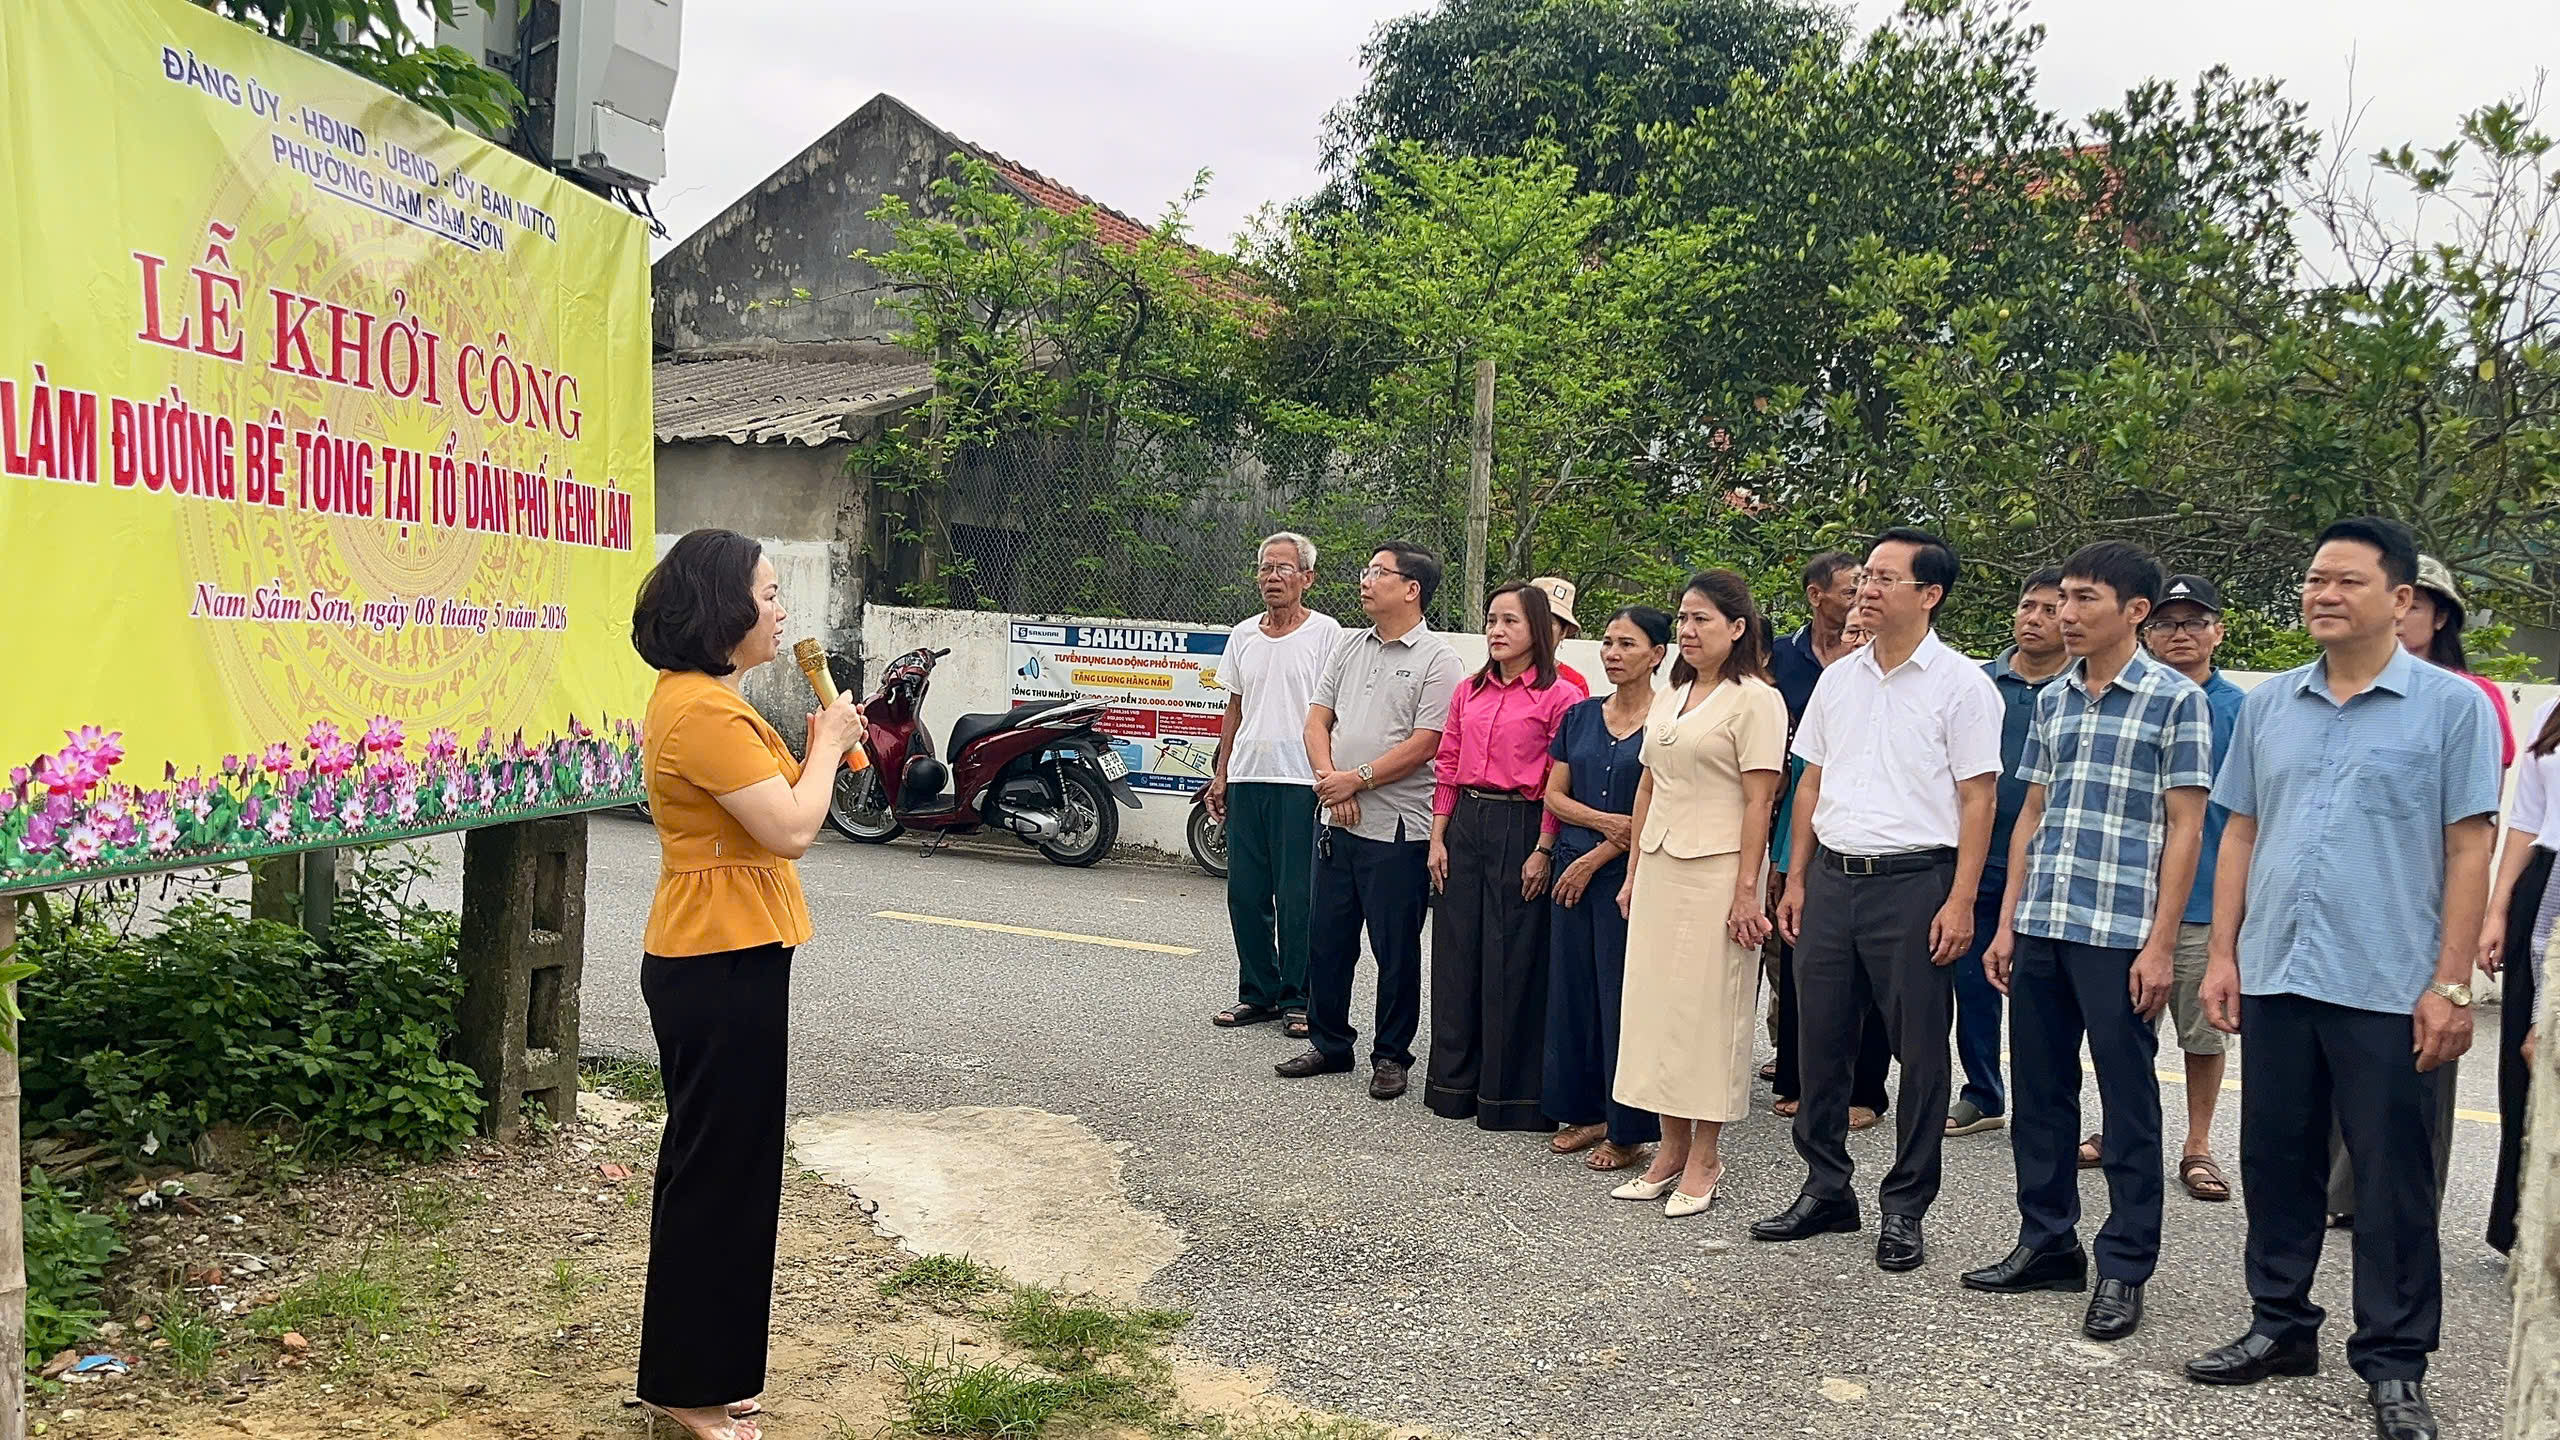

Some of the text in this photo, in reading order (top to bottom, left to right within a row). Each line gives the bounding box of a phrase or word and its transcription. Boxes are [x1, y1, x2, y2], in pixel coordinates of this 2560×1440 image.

[163, 47, 242, 106] ĐẢNG
[247, 78, 280, 122] ỦY
[302, 107, 366, 157] HĐND
[384, 142, 439, 188] UBND
[453, 167, 475, 204] ỦY
[481, 184, 512, 221] BAN
[518, 201, 557, 243] MTTQ
[272, 134, 374, 199] PHƯỜNG
[379, 177, 422, 219] NAM
[470, 215, 504, 252] SƠN
[132, 222, 582, 441] LỄ KHỞI CÔNG
[0, 364, 632, 551] LÀM ĐƯỜNG BÊ TÔNG TẠI TỔ DÂN PHỐ KÊNH LÂM
[191, 580, 567, 634] Nam Sầm Sơn, ngày 08 tháng 5 năm 2026
[1055, 650, 1081, 663] TUYỂN
[1083, 655, 1106, 667] DỤNG
[1107, 657, 1123, 665] LAO
[1124, 656, 1149, 669] ĐỘNG
[1150, 655, 1168, 669] PHỔ
[1078, 628, 1188, 652] SAKURAI
[1012, 684, 1031, 696] TỔNG
[1048, 689, 1070, 701] NHẬP
[1138, 698, 1184, 706] 20.000.000
[1074, 672, 1096, 682] TĂNG
[1126, 675, 1150, 685] HÀNG
